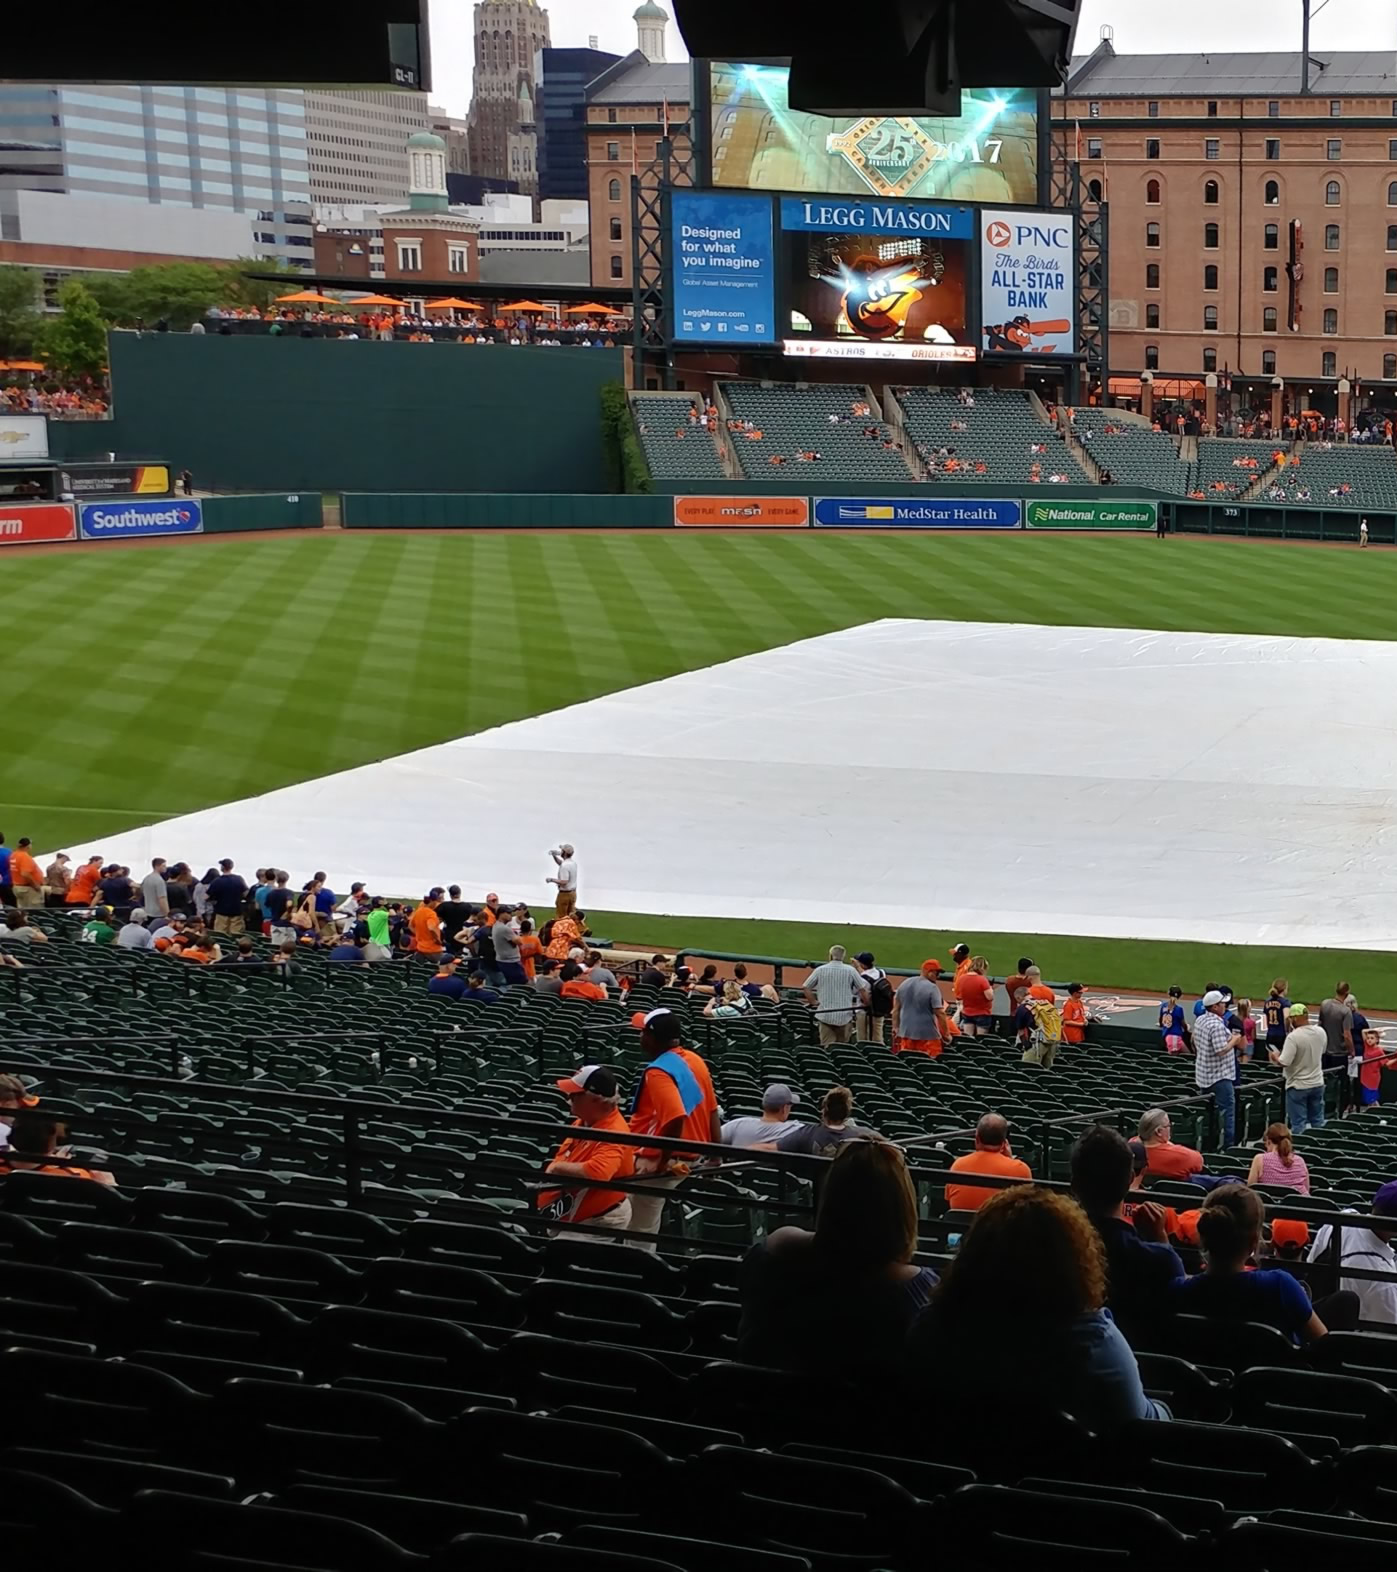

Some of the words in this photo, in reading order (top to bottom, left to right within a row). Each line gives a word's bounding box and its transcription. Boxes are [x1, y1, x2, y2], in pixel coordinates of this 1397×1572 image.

[867, 126, 914, 162] 25
[932, 138, 1003, 164] 2017
[851, 150, 887, 190] CAMDEN
[868, 159, 911, 167] ANNIVERSARY
[804, 203, 865, 227] LEGG
[872, 206, 952, 232] MASON
[681, 225, 741, 241] Designed
[1015, 225, 1069, 249] PNC
[681, 240, 700, 252] for
[703, 242, 736, 253] what
[682, 256, 706, 268] you
[709, 255, 760, 270] imagine
[995, 253, 1020, 268] The
[1023, 255, 1060, 271] Birds
[682, 279, 701, 287] Global
[720, 280, 758, 289] Management
[991, 270, 1065, 290] ALL-STAR
[1008, 290, 1048, 309] BANK
[683, 309, 745, 318] LeggMason.com
[825, 347, 866, 356] ASTROS
[911, 350, 951, 359] ORIOLES
[93, 508, 180, 530] Southwest
[720, 507, 763, 516] masn
[897, 508, 951, 520] MedStar
[954, 509, 997, 520] Health
[1048, 509, 1094, 521] National
[1099, 512, 1117, 521] Car
[1118, 512, 1149, 522] Rental
[1224, 508, 1238, 516] 373
